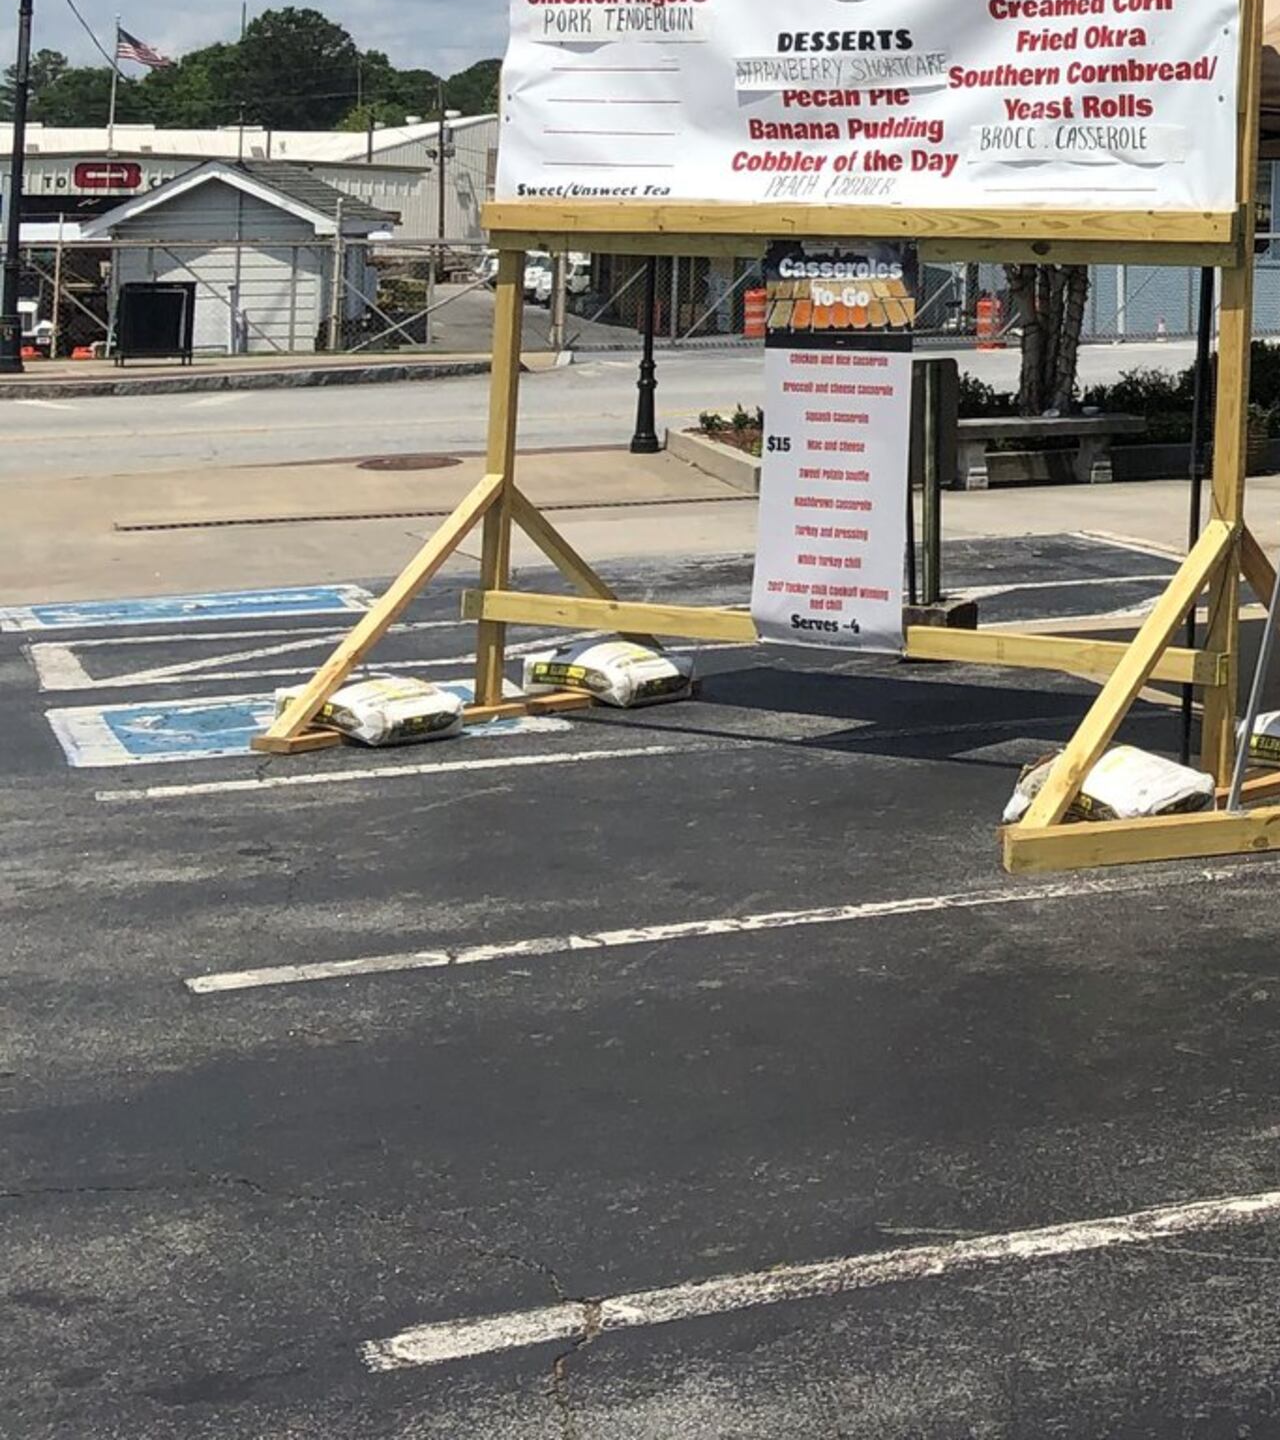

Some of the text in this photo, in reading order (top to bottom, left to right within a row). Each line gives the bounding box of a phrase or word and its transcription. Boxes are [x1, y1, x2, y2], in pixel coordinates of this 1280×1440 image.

[543, 9, 592, 34] PORK
[777, 29, 913, 52] DESSERTS
[1016, 25, 1147, 52] Fried Okra
[736, 53, 947, 86] STRAWBERRY SHORTCAKE
[948, 55, 1218, 89] Southern Cornbread/
[783, 88, 910, 107] Pecan Pie
[1004, 94, 1154, 121] Yeast Rolls
[749, 117, 945, 143] Banana Pudding
[1055, 125, 1148, 151] CASSEROLE
[731, 149, 959, 178] Cobbler of the Day
[517, 182, 671, 198] Sweet/Unsweet Tea
[778, 258, 903, 279] Casseroles
[812, 285, 870, 307] To-Go
[767, 434, 791, 453] $15
[790, 614, 839, 633] Serves
